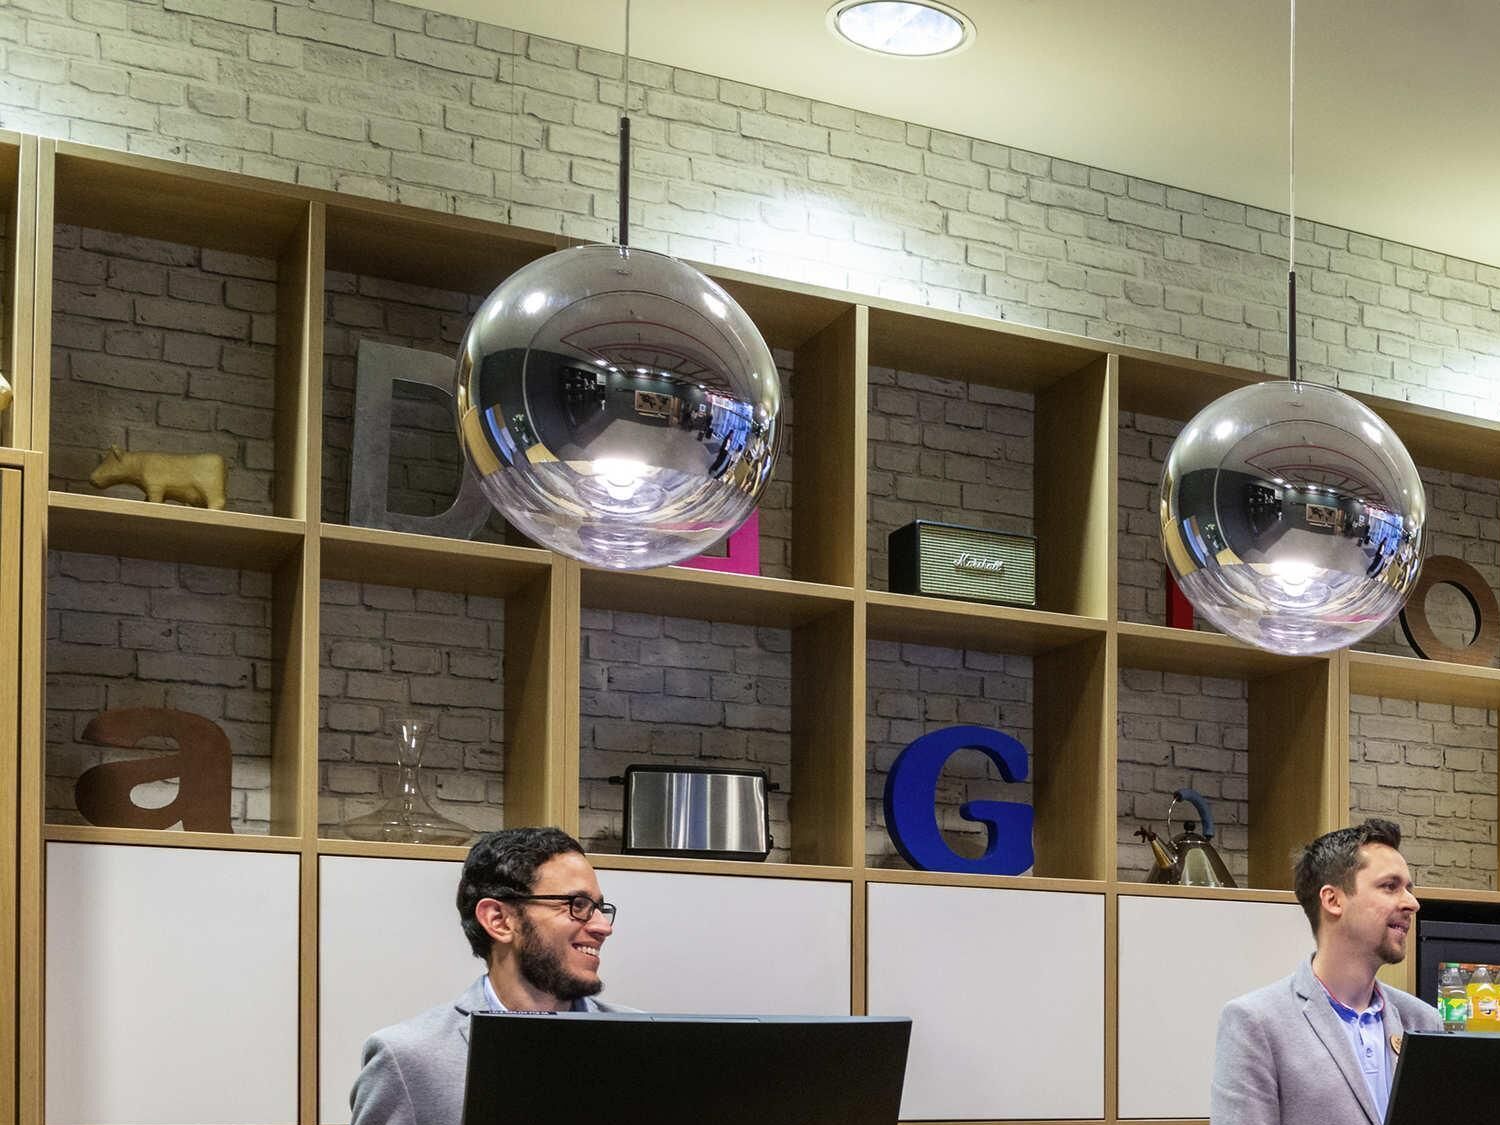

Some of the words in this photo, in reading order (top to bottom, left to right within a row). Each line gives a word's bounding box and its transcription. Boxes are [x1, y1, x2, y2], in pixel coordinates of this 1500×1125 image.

[952, 552, 1004, 571] Marshall
[75, 708, 234, 834] a
[884, 725, 1034, 876] G
